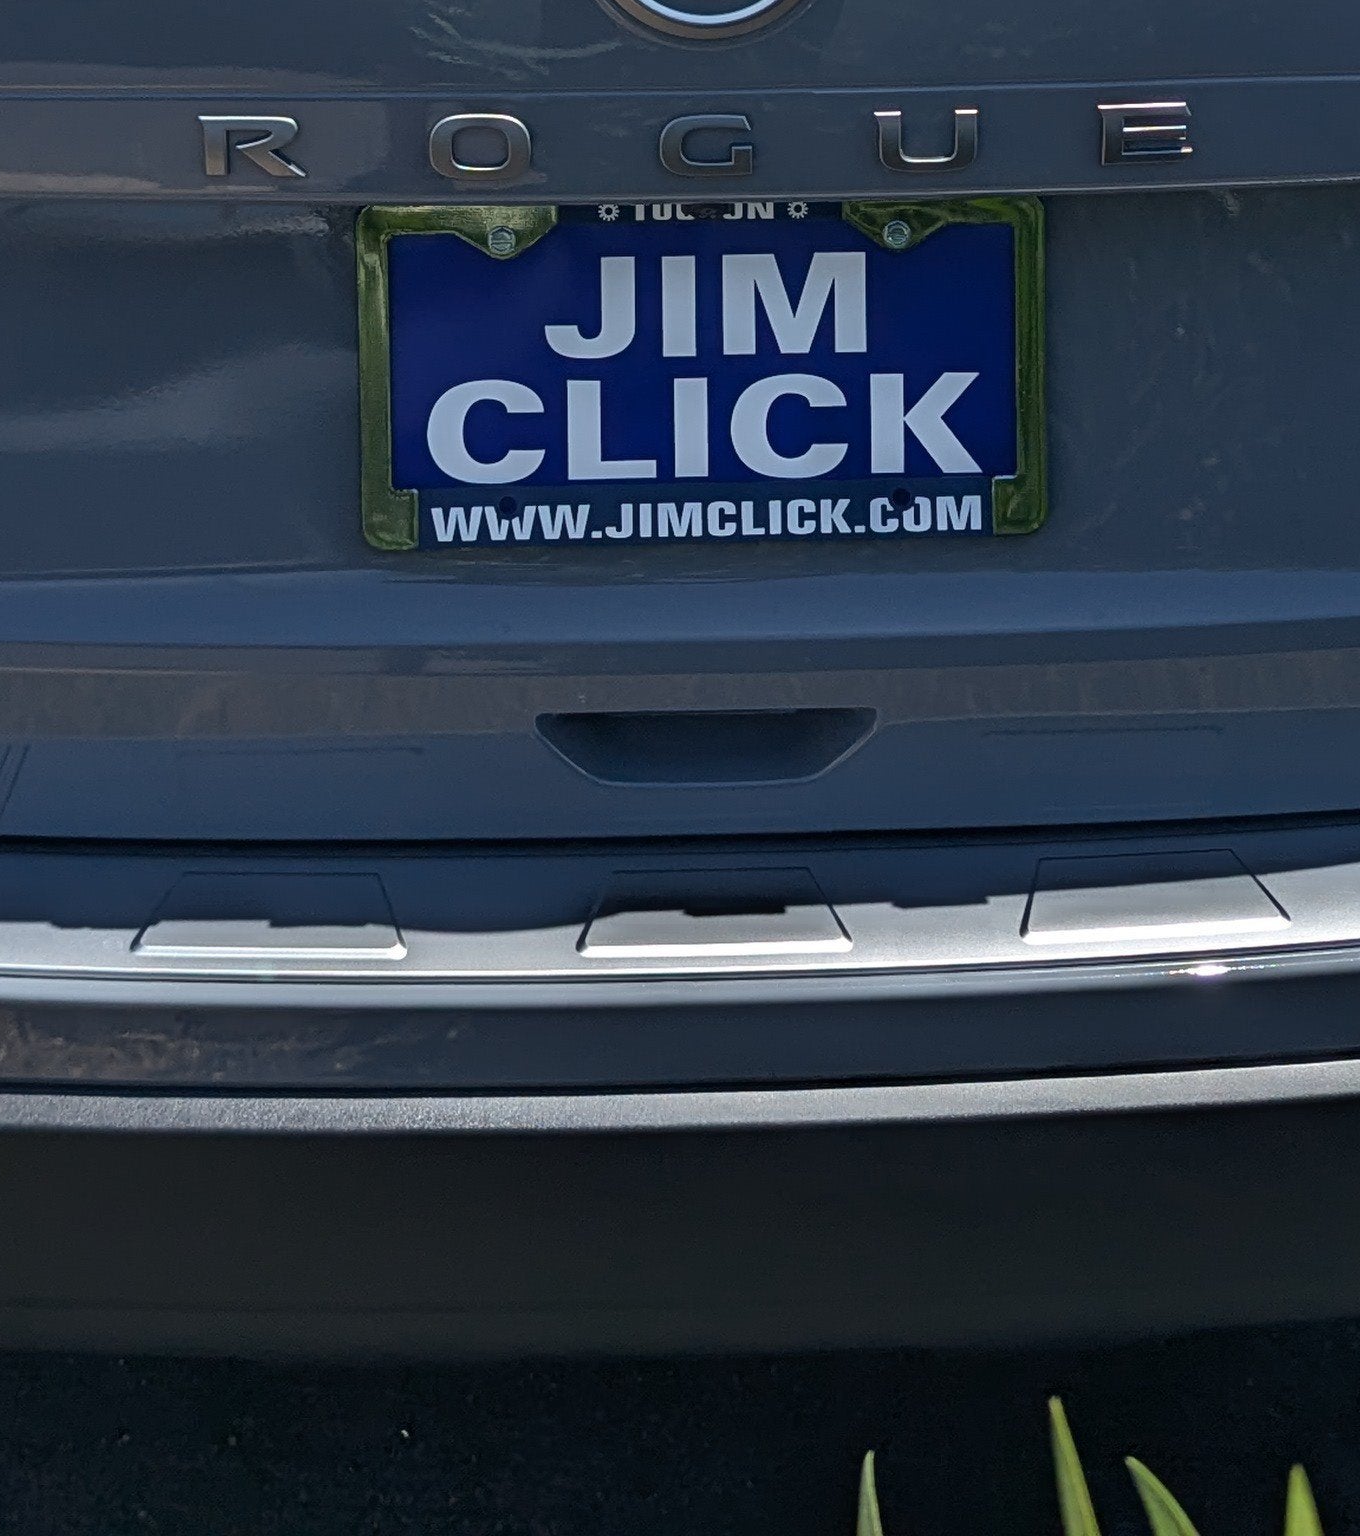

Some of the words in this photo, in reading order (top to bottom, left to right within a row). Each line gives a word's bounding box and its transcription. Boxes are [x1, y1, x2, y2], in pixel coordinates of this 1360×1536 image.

[197, 100, 1194, 179] ROGUE
[544, 251, 868, 360] JIM
[425, 371, 984, 485] CLICK
[430, 494, 983, 543] WWW.JIMCLICK.COM
